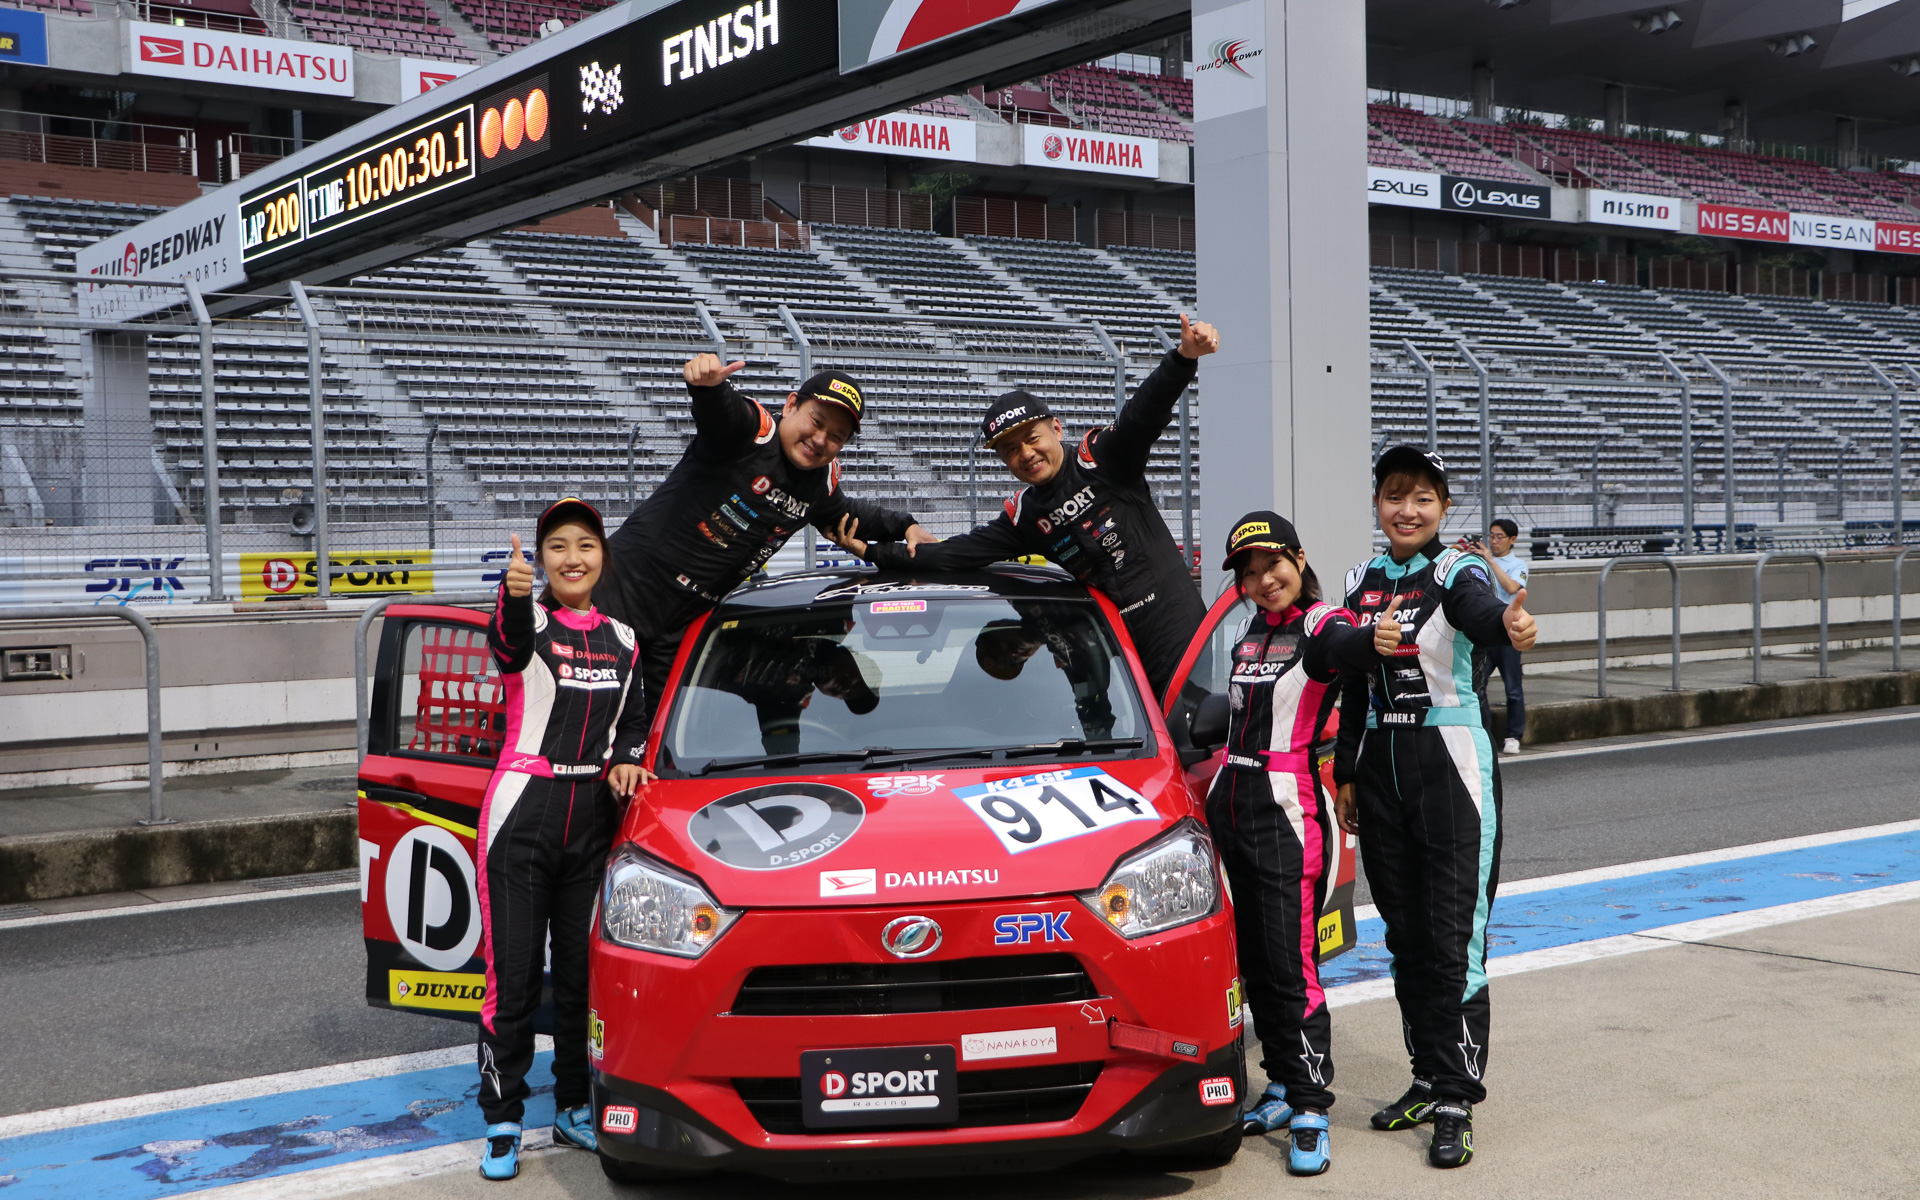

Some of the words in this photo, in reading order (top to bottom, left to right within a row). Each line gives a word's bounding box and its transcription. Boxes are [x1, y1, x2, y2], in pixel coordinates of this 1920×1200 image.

[663, 0, 779, 86] FINISH
[193, 42, 347, 83] DAIHATSU
[865, 118, 951, 151] YAMAHA
[1066, 136, 1143, 169] YAMAHA
[308, 178, 344, 224] TIME
[346, 121, 469, 211] 10:00:30.1
[1368, 179, 1429, 197] EXUS
[1476, 189, 1540, 209] LEXUS
[241, 211, 266, 250] LAP
[266, 192, 300, 242] 200
[1602, 199, 1669, 219] nismo
[1701, 210, 1788, 236] NISSAN
[1792, 219, 1872, 243] NISSAN
[995, 406, 1026, 427] SPORT
[765, 488, 810, 518] SPORT
[1048, 485, 1096, 526] SPORT
[1238, 525, 1267, 538] SPORT
[84, 557, 186, 593] SPK
[1372, 607, 1421, 625] SORT
[576, 650, 618, 663] DAIHATSU
[1245, 662, 1285, 675] SPORT
[575, 667, 618, 681] SPORT
[1383, 712, 1416, 724] KAREN.S
[867, 774, 946, 790] SPK
[985, 769, 1073, 793] K4-GP
[723, 794, 832, 852] D
[980, 778, 1144, 844] 914
[770, 832, 841, 865] D-SPORT
[885, 868, 999, 887] DAIHATSU
[406, 837, 472, 952] D
[993, 911, 1073, 945] SPK
[414, 982, 486, 1000] DUNLO
[987, 1036, 1056, 1052] NANAKOYA
[851, 1069, 939, 1095] SPORT
[1206, 1084, 1229, 1098] PRO
[853, 1099, 908, 1107] Racing
[608, 1112, 631, 1126] PRO
